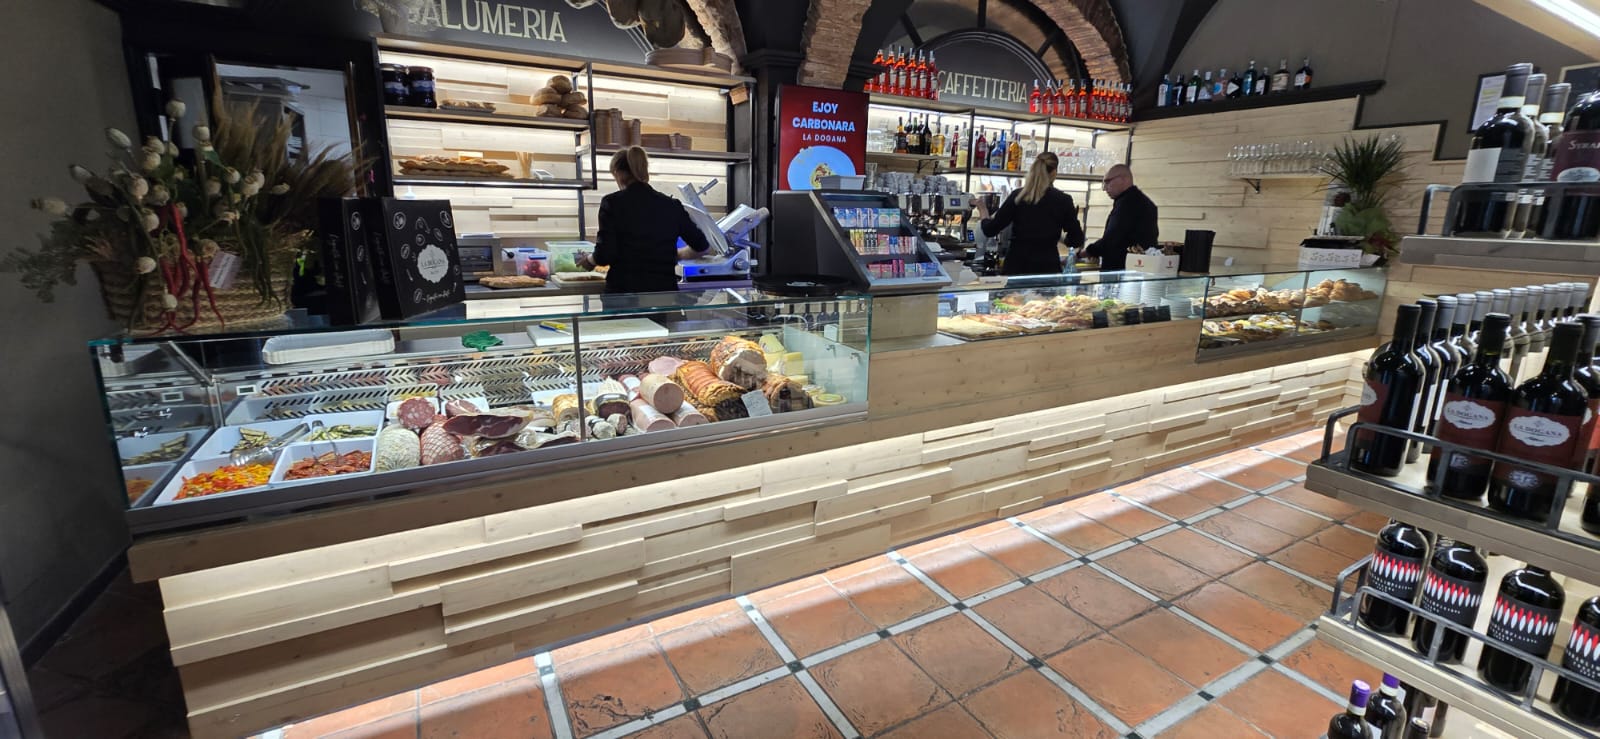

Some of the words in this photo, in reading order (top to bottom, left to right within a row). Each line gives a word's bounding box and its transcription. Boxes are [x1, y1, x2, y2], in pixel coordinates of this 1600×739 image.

[937, 70, 1028, 104] CAFFETTERIA
[812, 101, 839, 114] EJOY
[792, 117, 856, 132] CARBONARA
[814, 134, 847, 143] DOGANA
